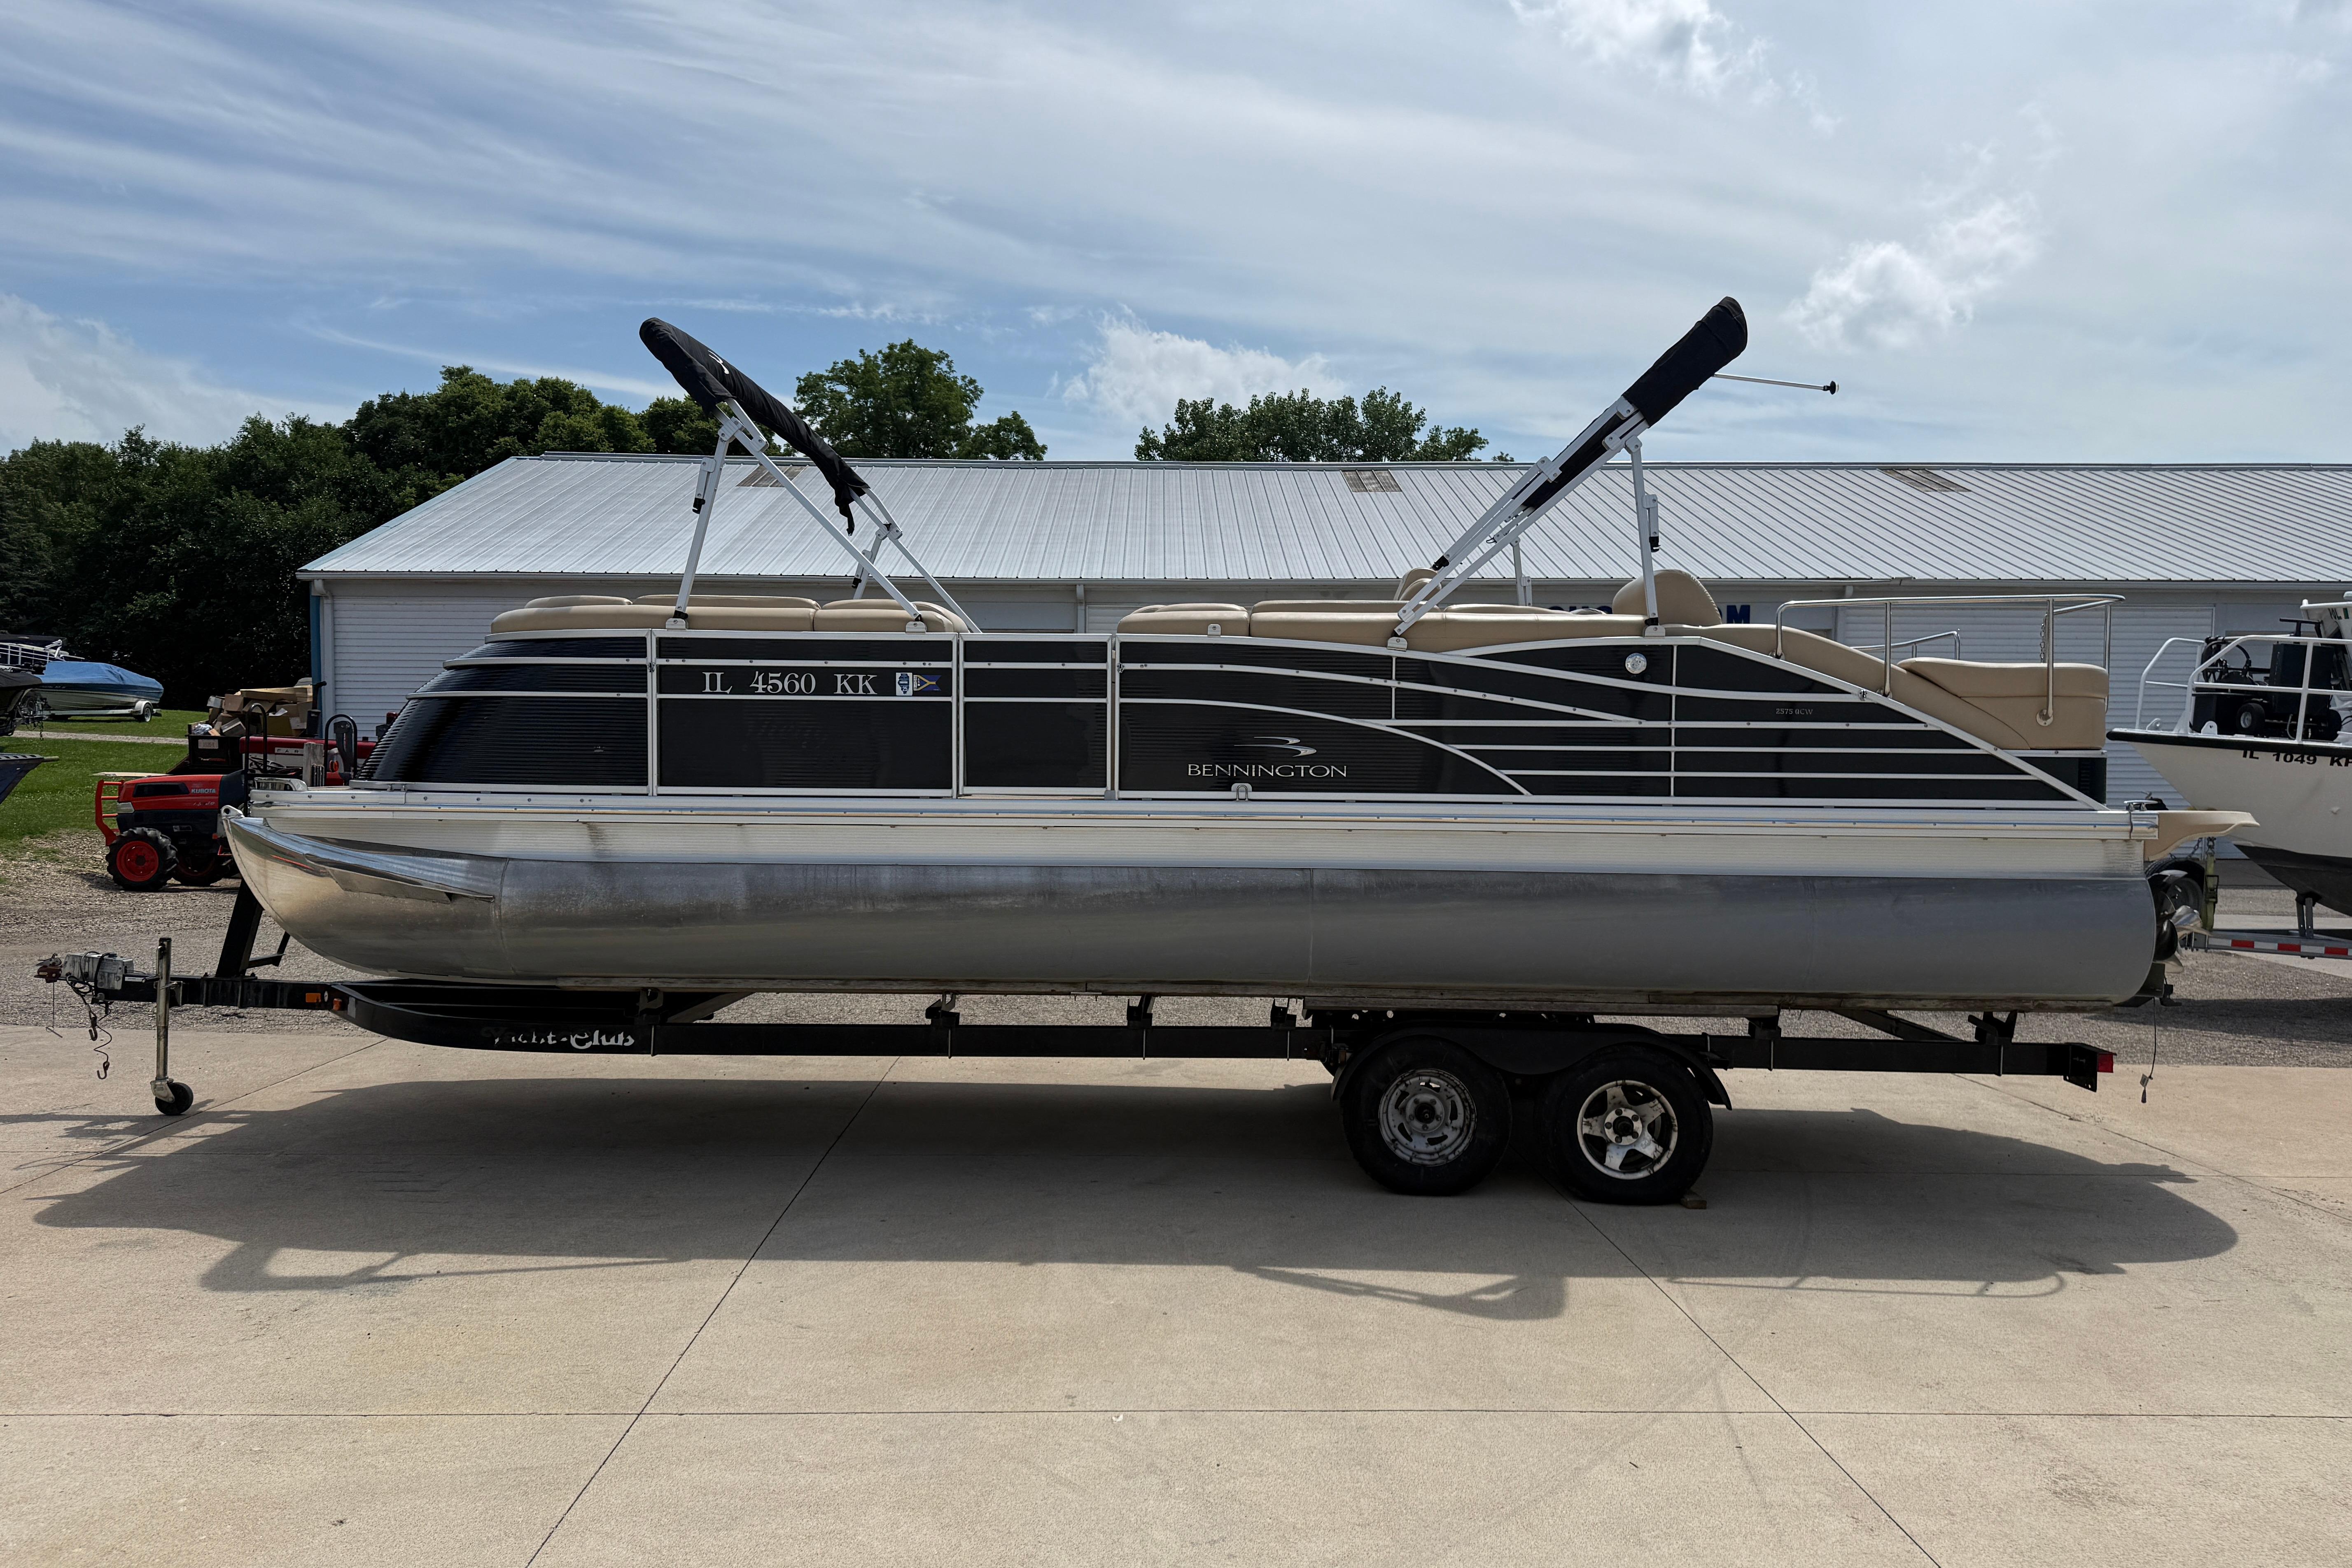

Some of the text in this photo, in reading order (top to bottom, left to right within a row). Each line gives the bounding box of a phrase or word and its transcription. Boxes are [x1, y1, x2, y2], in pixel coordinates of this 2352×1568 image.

[702, 672, 733, 694] IL
[749, 671, 816, 694] 4560
[833, 674, 878, 695] KK
[2242, 750, 2259, 760] IL
[2273, 752, 2317, 765] 1049
[1188, 764, 1347, 777] BENNINGTON
